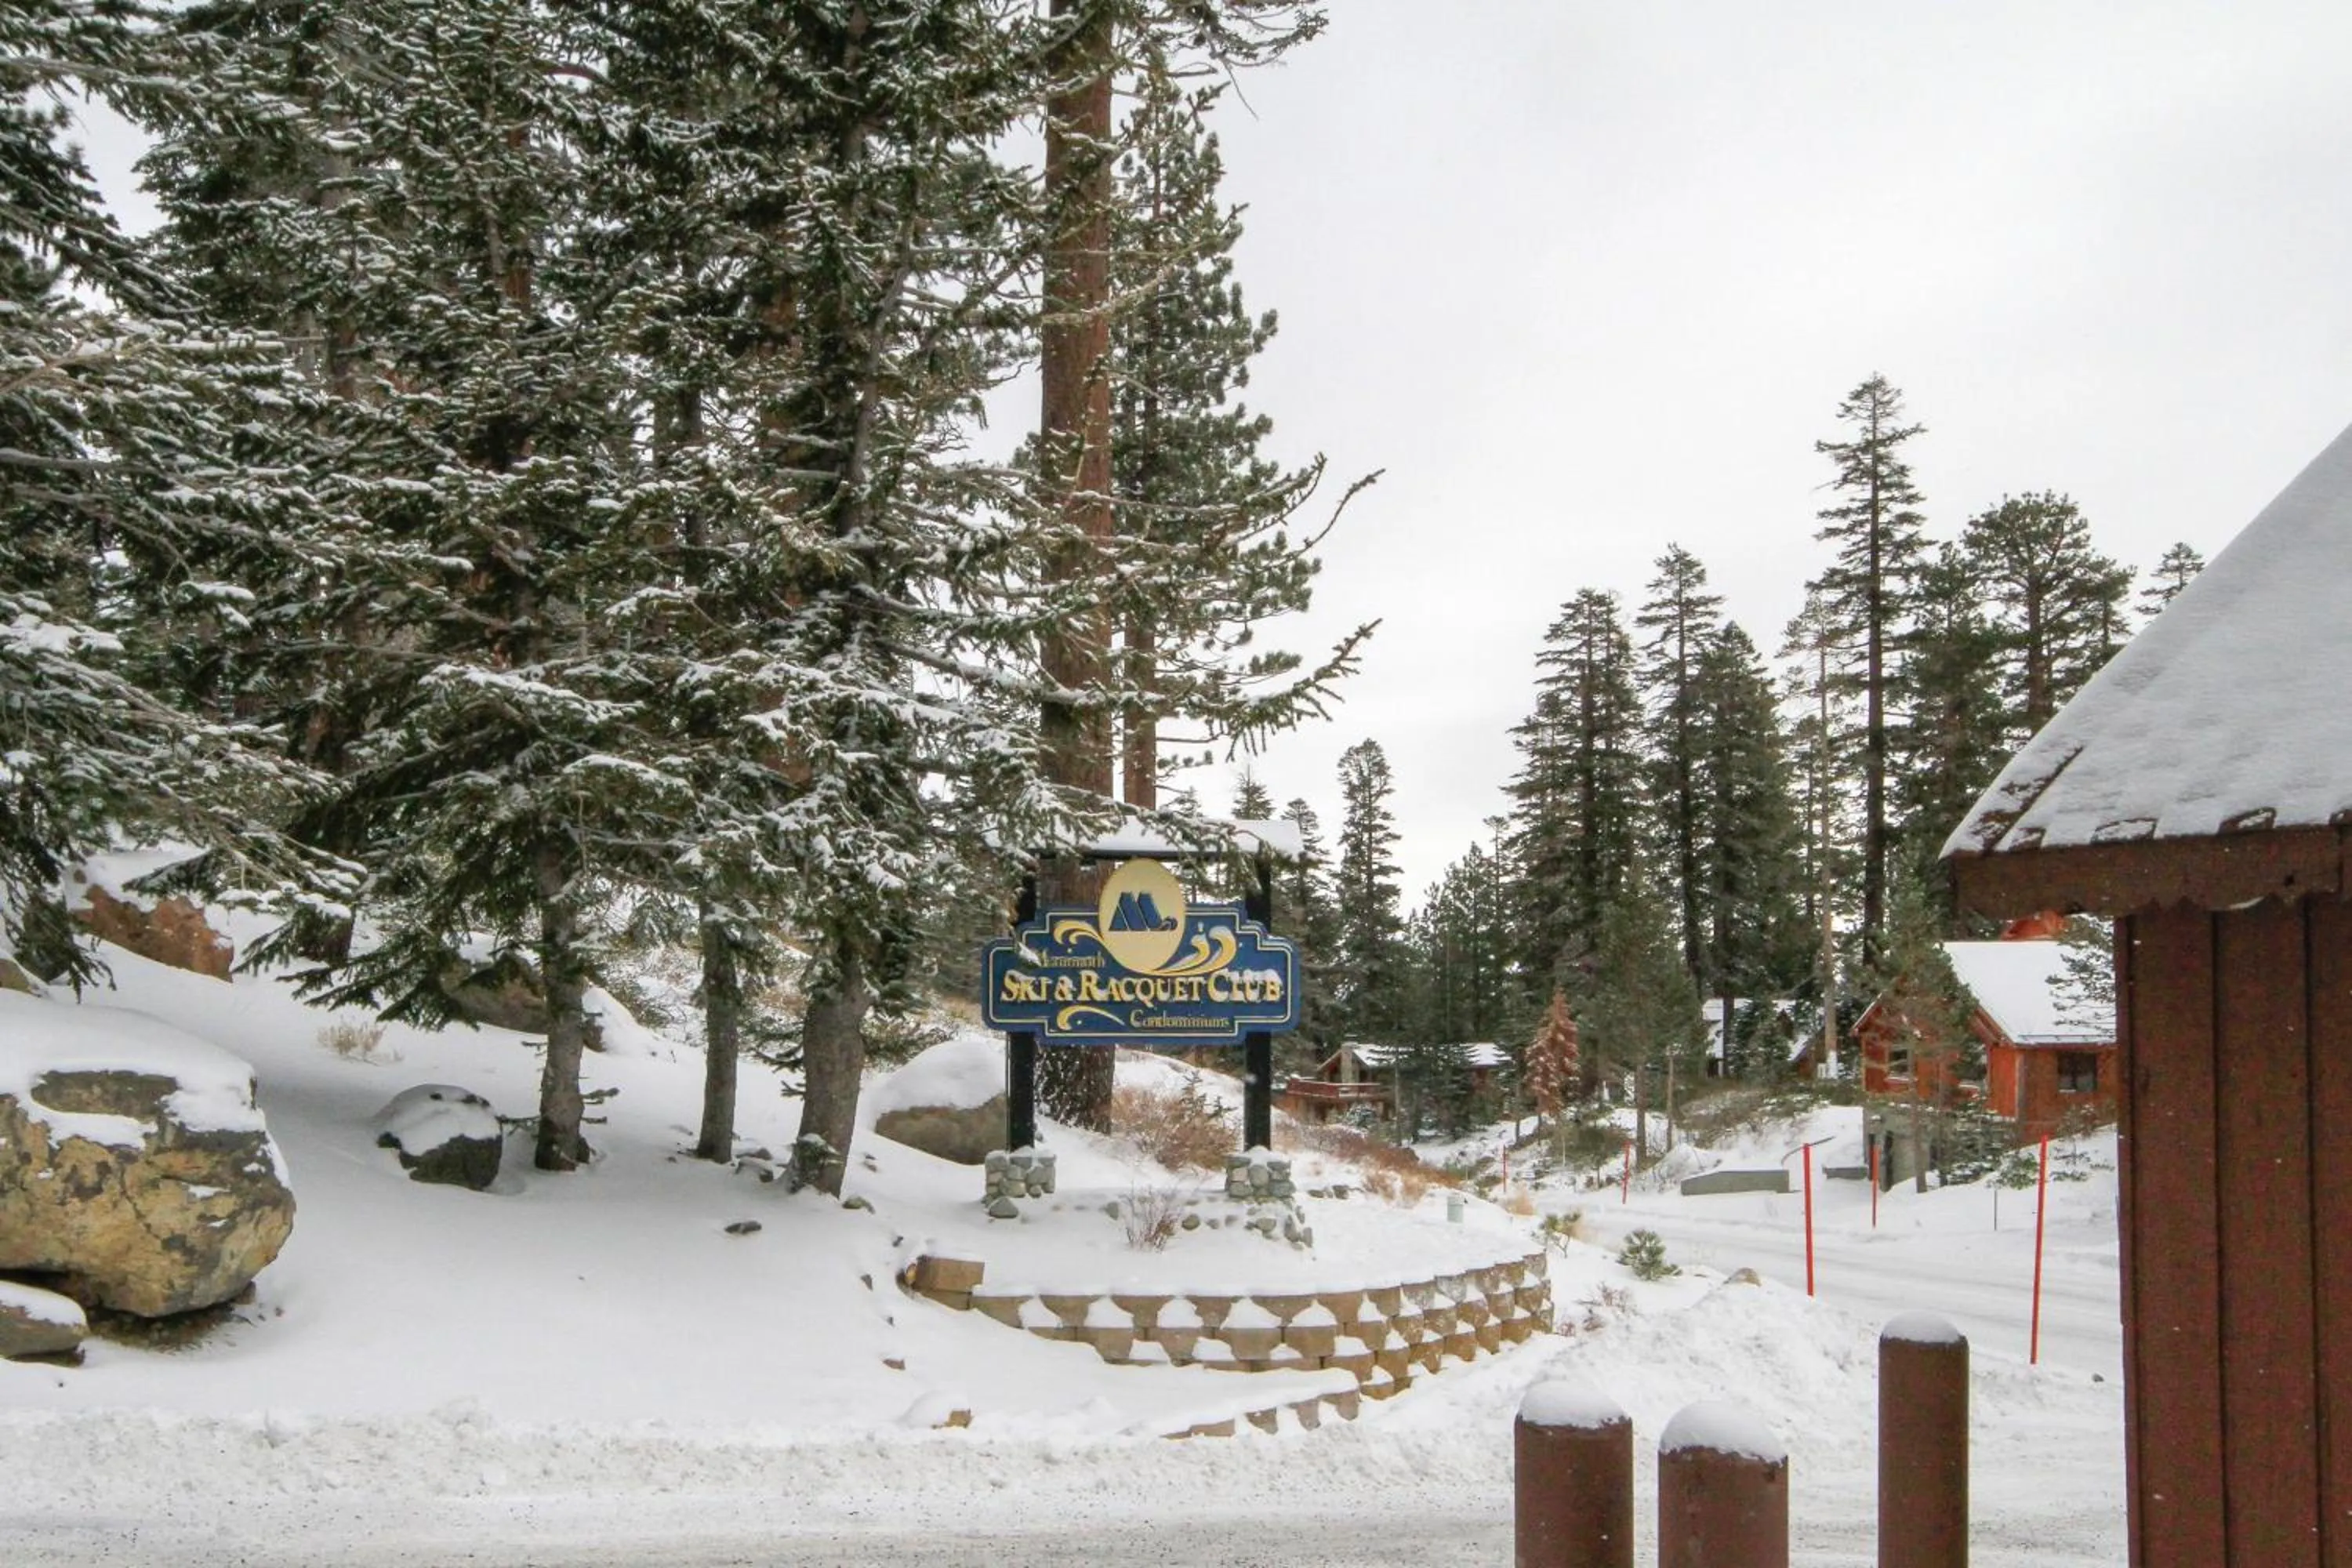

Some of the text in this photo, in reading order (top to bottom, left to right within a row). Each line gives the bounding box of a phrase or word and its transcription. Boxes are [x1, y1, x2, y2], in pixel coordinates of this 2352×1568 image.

[1000, 969, 1283, 1007] SKI & RACQUET CLUB
[1131, 1009, 1230, 1028] Condominiums
